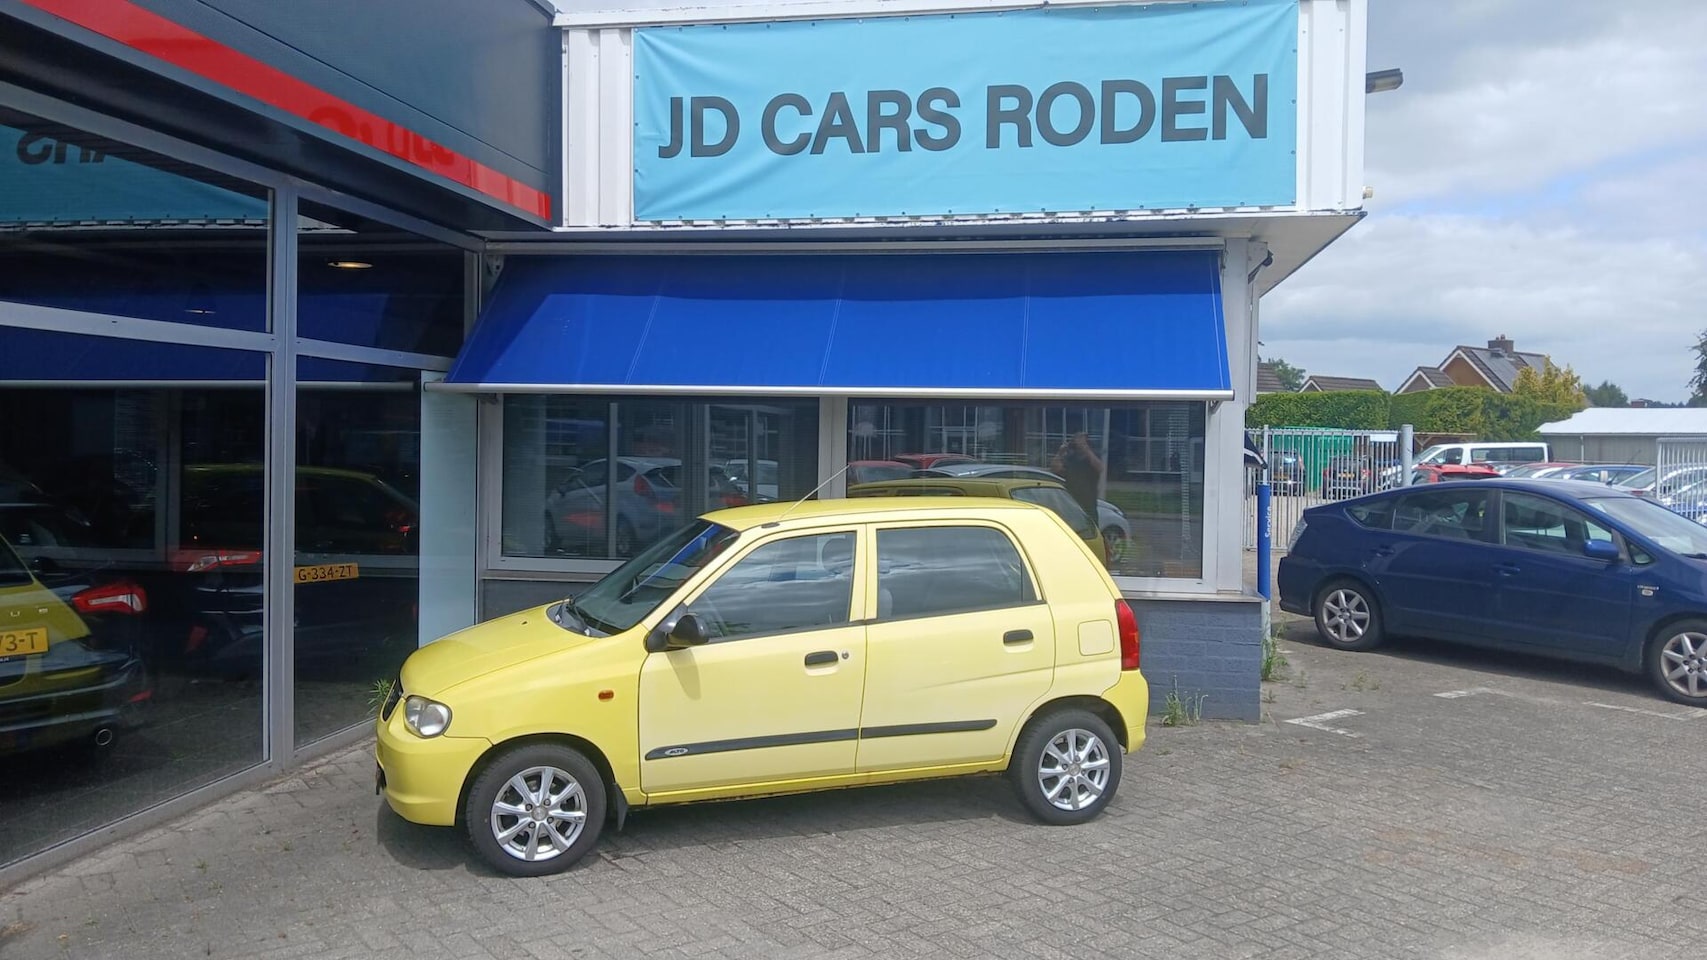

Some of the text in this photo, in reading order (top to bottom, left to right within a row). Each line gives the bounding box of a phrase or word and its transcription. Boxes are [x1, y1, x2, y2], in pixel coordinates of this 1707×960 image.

[658, 73, 1269, 158] JD CARS RODEN
[298, 565, 353, 581] G-334-ZT
